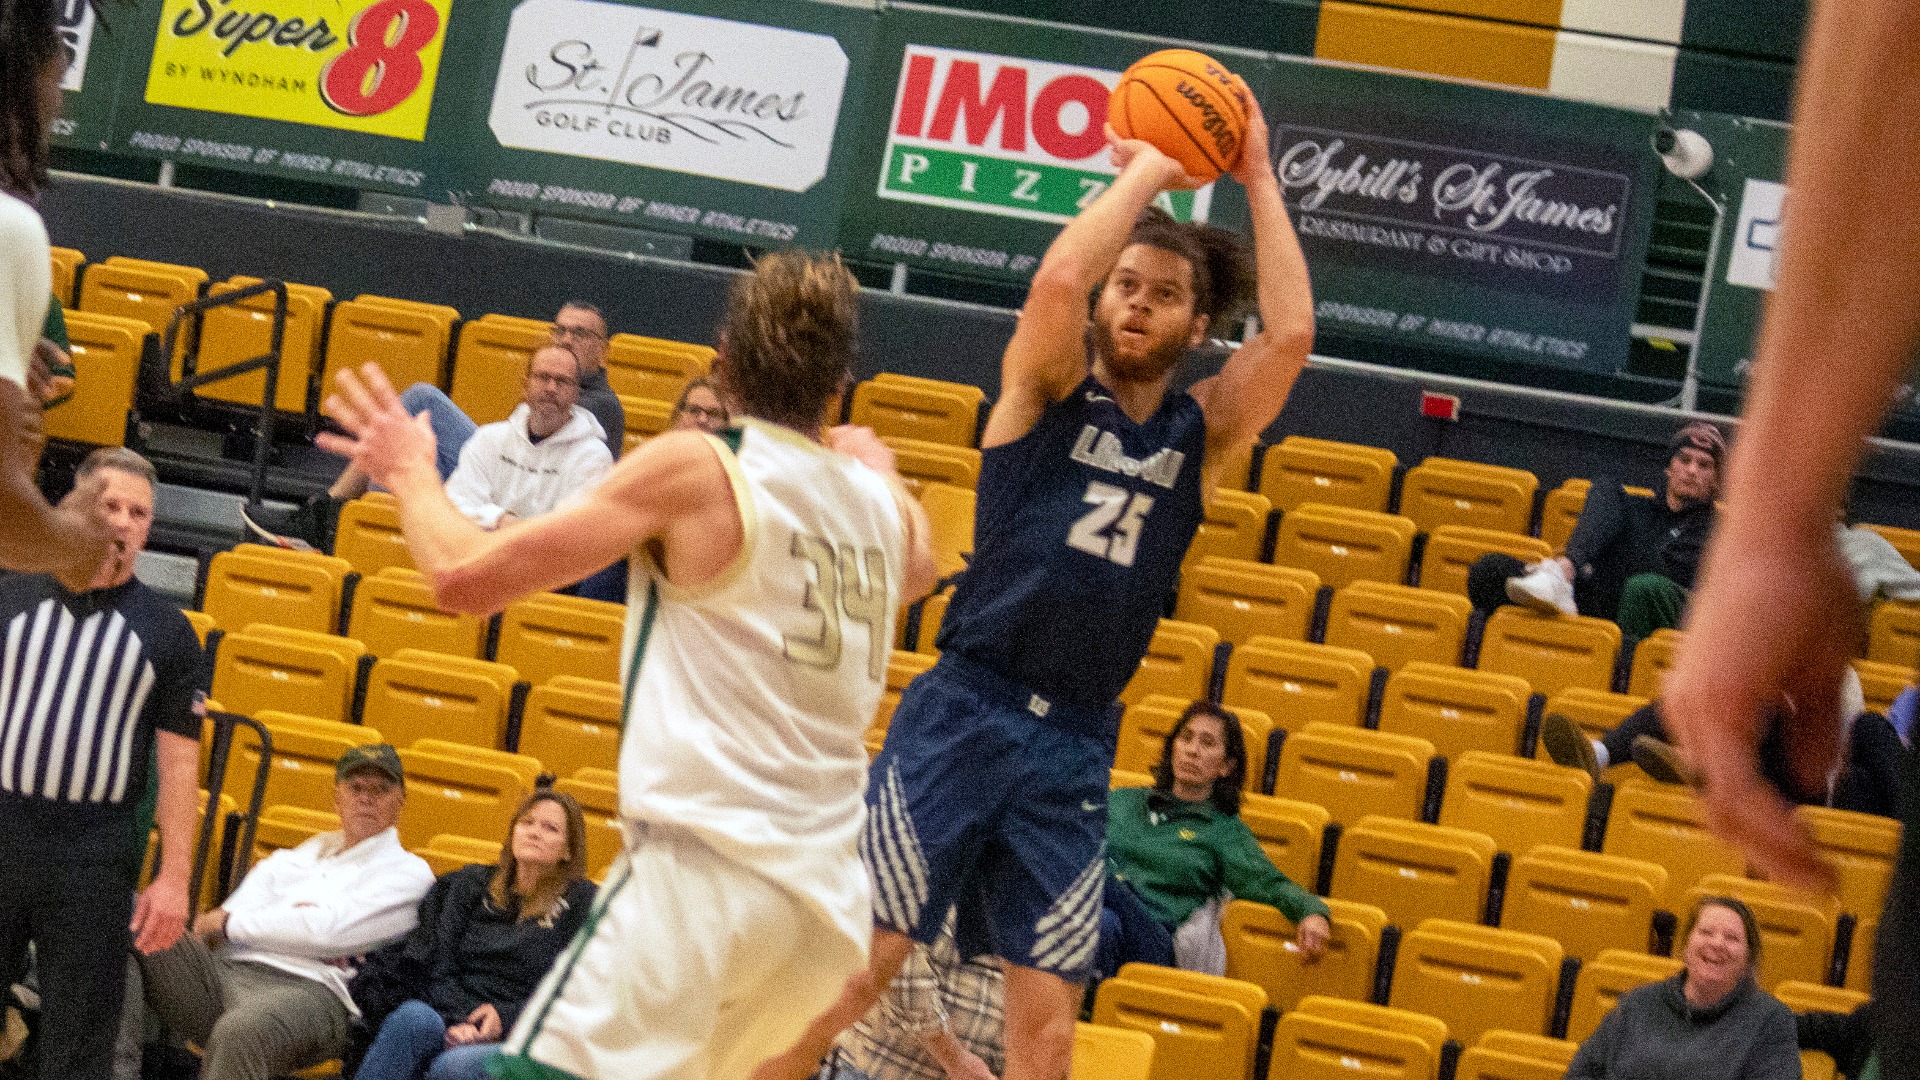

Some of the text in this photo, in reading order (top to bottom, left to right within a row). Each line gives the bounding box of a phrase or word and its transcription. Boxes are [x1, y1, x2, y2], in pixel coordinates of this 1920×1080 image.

[164, 61, 307, 94] BY WYNDHAM
[172, 0, 338, 57] Super
[318, 0, 440, 116] 8
[525, 38, 809, 123] St. James
[535, 110, 673, 144] GOLF CLUB
[129, 130, 426, 188] PROUD SPONSOR OF MINER ATHLETICS
[1279, 140, 1422, 211] Sybill's
[1466, 168, 1617, 235] James
[487, 178, 799, 241] PROUD SPONSOR OF MINER ATHLETICS
[870, 233, 1037, 272] PROUD SPONSOR OF
[1299, 214, 1425, 251] RESTAURANT
[1452, 237, 1502, 264] GIFT
[1502, 247, 1573, 274] SHOP
[1317, 302, 1398, 328] SPONSOR
[1398, 314, 1427, 332] OF
[1486, 329, 1589, 360] ATHLETICS
[1066, 481, 1156, 567] 25
[782, 531, 887, 682] 34
